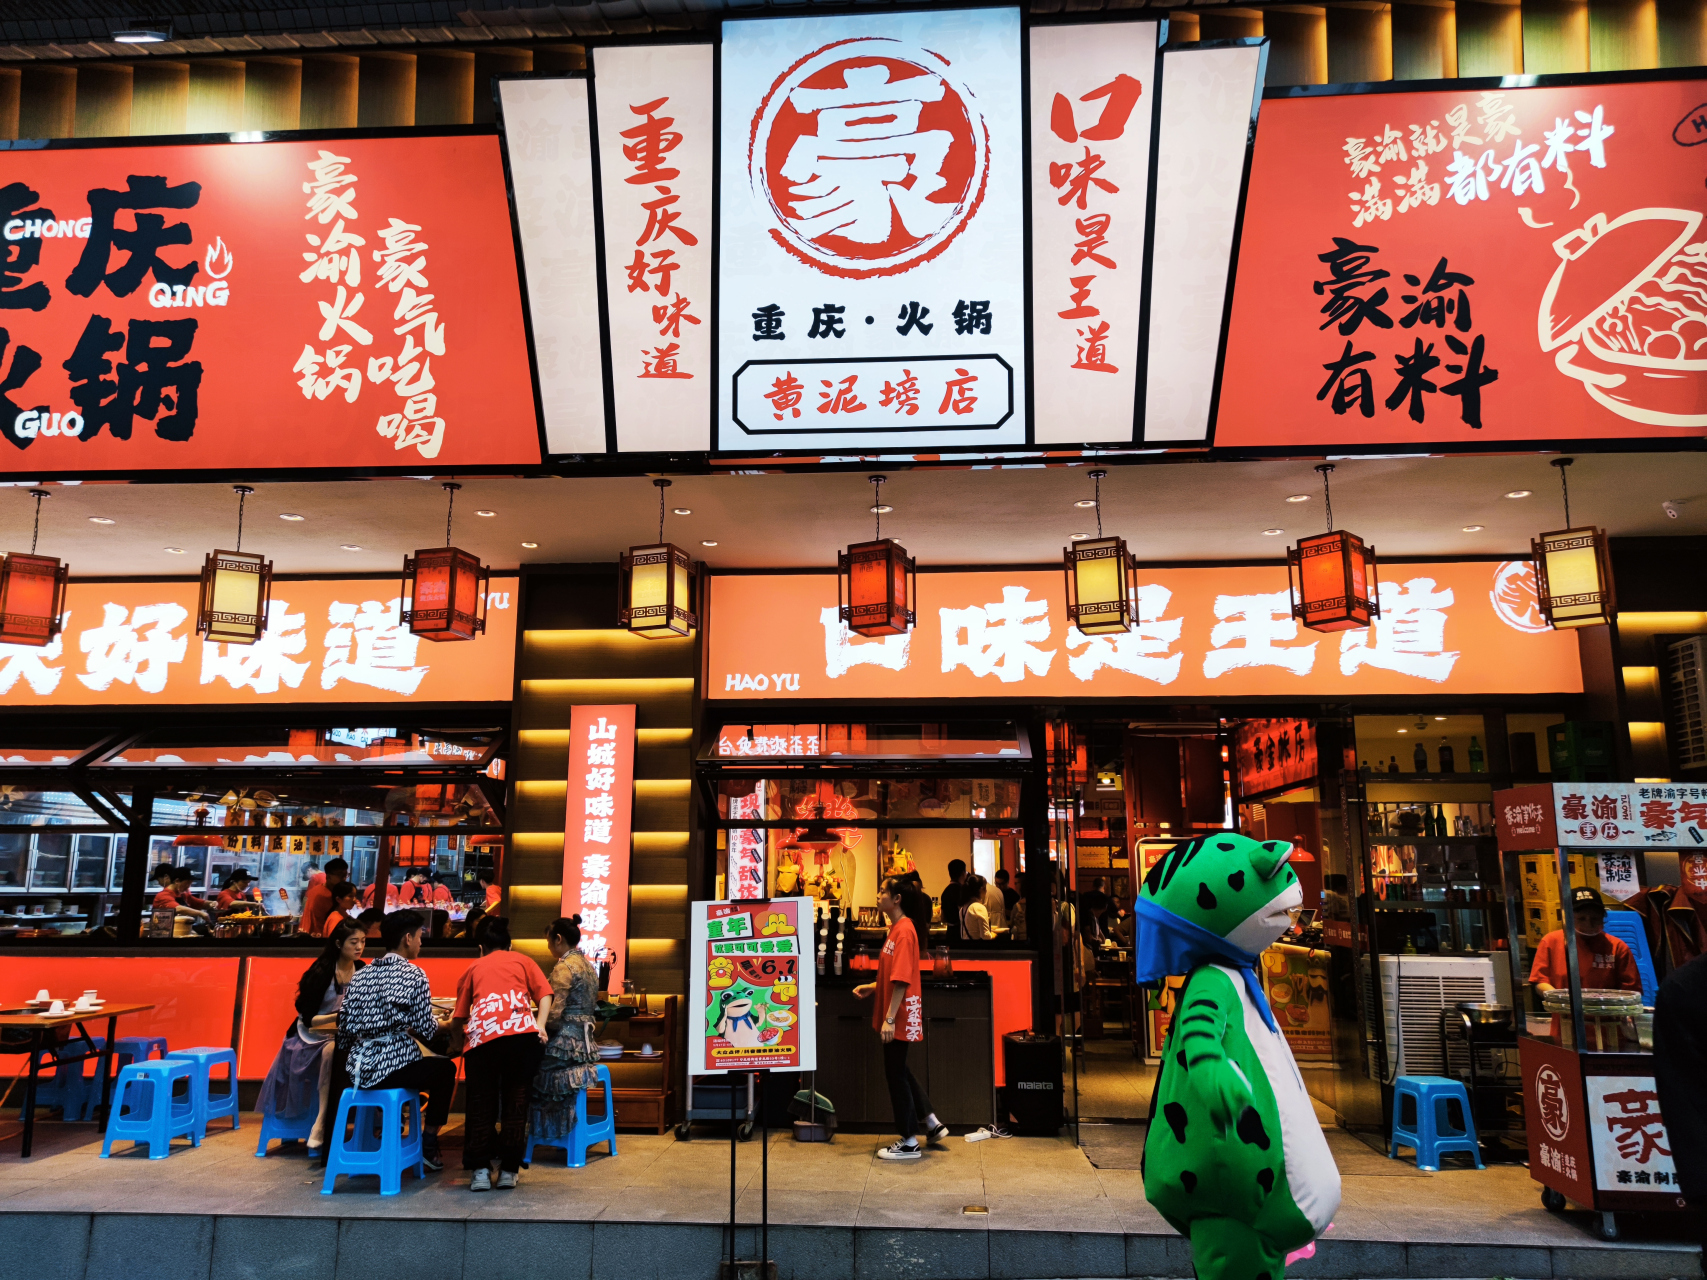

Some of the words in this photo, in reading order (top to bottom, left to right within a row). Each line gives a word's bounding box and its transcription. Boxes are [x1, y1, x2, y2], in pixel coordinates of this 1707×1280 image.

[780, 64, 958, 243] 豪
[1342, 92, 1521, 179] 豪渝就是豪
[1347, 104, 1615, 228] 满满都有料
[3, 217, 93, 241] CHONG
[619, 97, 701, 379] 重庆好味道
[1048, 73, 1143, 375] 口味是王道
[148, 280, 230, 308] QING
[292, 150, 373, 403] 豪渝火锅
[1312, 237, 1475, 335] 豪渝
[367, 217, 446, 459] 豪气吃喝
[763, 368, 979, 421] 黄泥塝店
[1316, 334, 1498, 429] 有料
[14, 411, 84, 439] GUO
[820, 577, 1461, 685] 口味是王道
[725, 674, 769, 691] HAO
[770, 674, 800, 691] YU
[583, 717, 618, 844] 山城好味道
[1561, 793, 1618, 821] 豪渝
[1602, 851, 1631, 868] 豪渝
[1605, 868, 1632, 883] 制造
[579, 854, 611, 979] 豪渝够地
[707, 916, 748, 938] 童年
[714, 938, 793, 953] 就要可可爱爱
[761, 959, 796, 976] 6.1
[1017, 1081, 1054, 1090] malata
[1539, 1142, 1562, 1174] 豪渝
[1603, 1088, 1672, 1164] 豪
